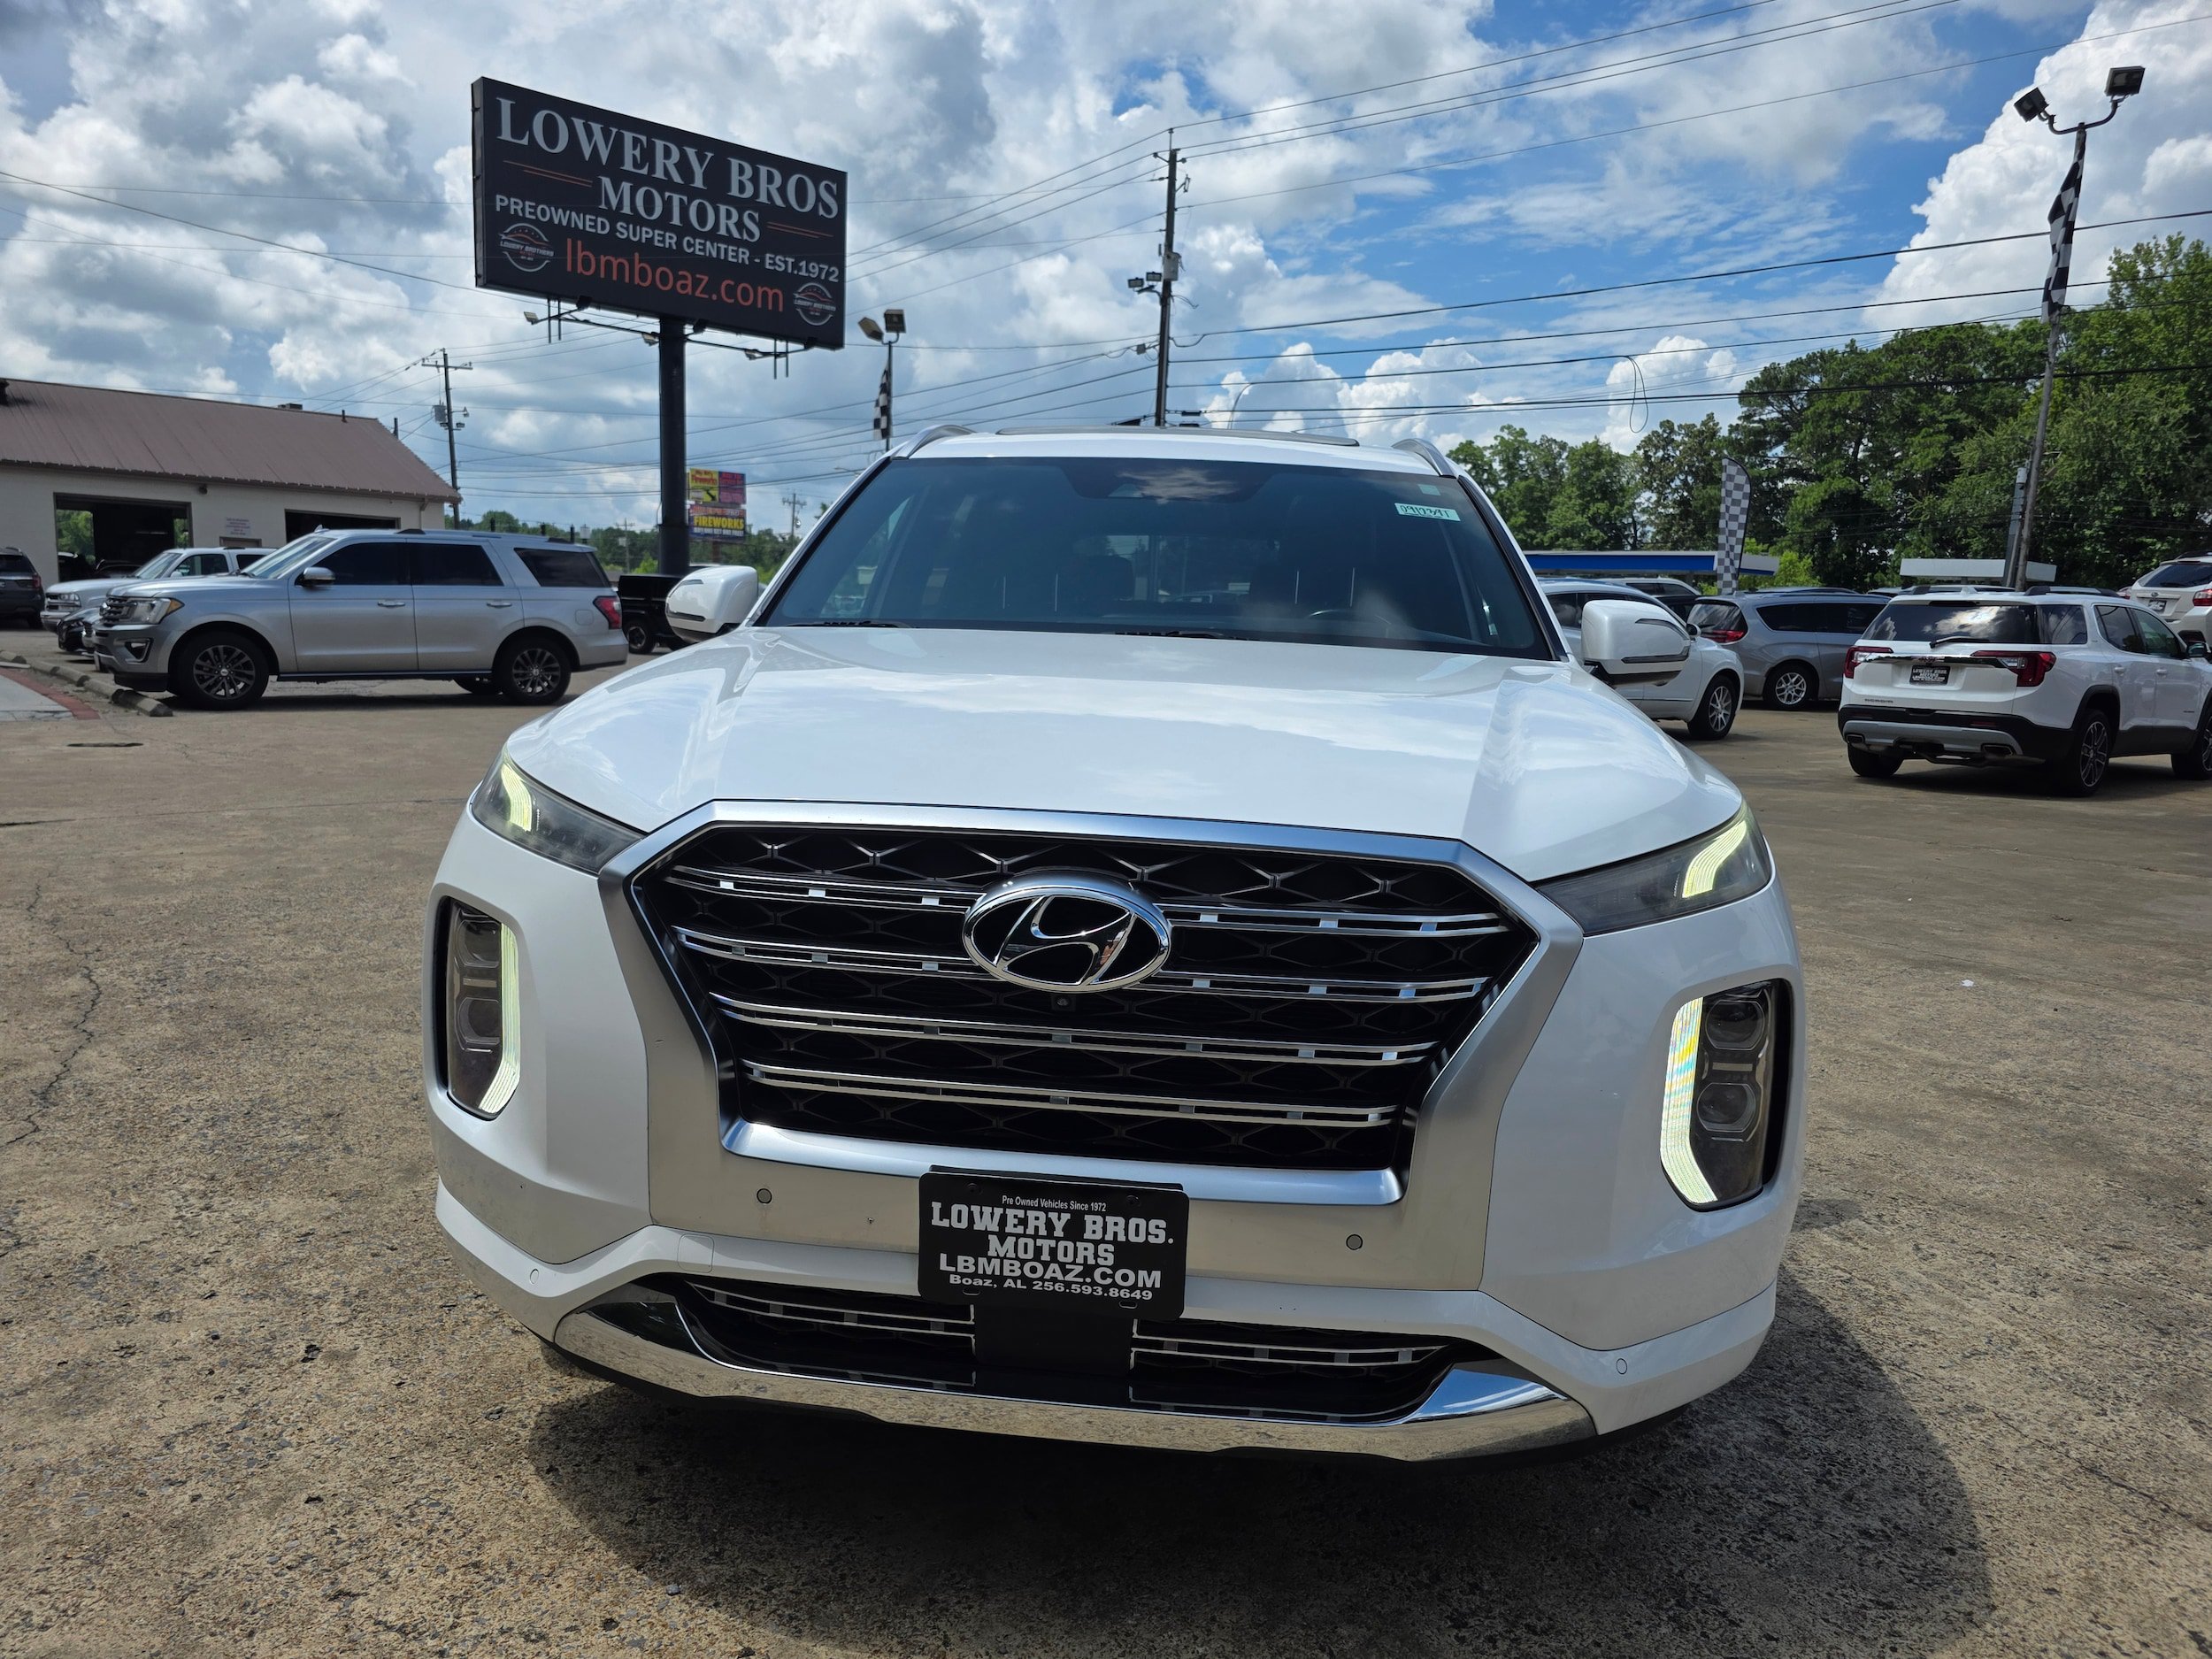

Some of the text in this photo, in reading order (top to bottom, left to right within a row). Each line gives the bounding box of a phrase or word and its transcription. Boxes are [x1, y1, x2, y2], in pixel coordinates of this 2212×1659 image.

[496, 97, 839, 219] LOWERY BROS
[598, 175, 761, 242] MOTORS
[495, 194, 611, 235] PREOWNED
[616, 221, 678, 250] SUPER
[682, 235, 750, 265] CENTER
[764, 252, 840, 283] EST.1972
[566, 237, 784, 312] lbmboaz.com
[694, 515, 744, 530] FIREWORKS
[931, 1201, 1174, 1244] LOWERY BROS.
[1002, 1194, 1107, 1212] Pre Owned Vehicles Since 1972
[987, 1233, 1115, 1266] MOTORS
[939, 1252, 1162, 1289] LBMBOAZ.COM
[949, 1273, 1153, 1301] Boaz, AL 256.593.8649
